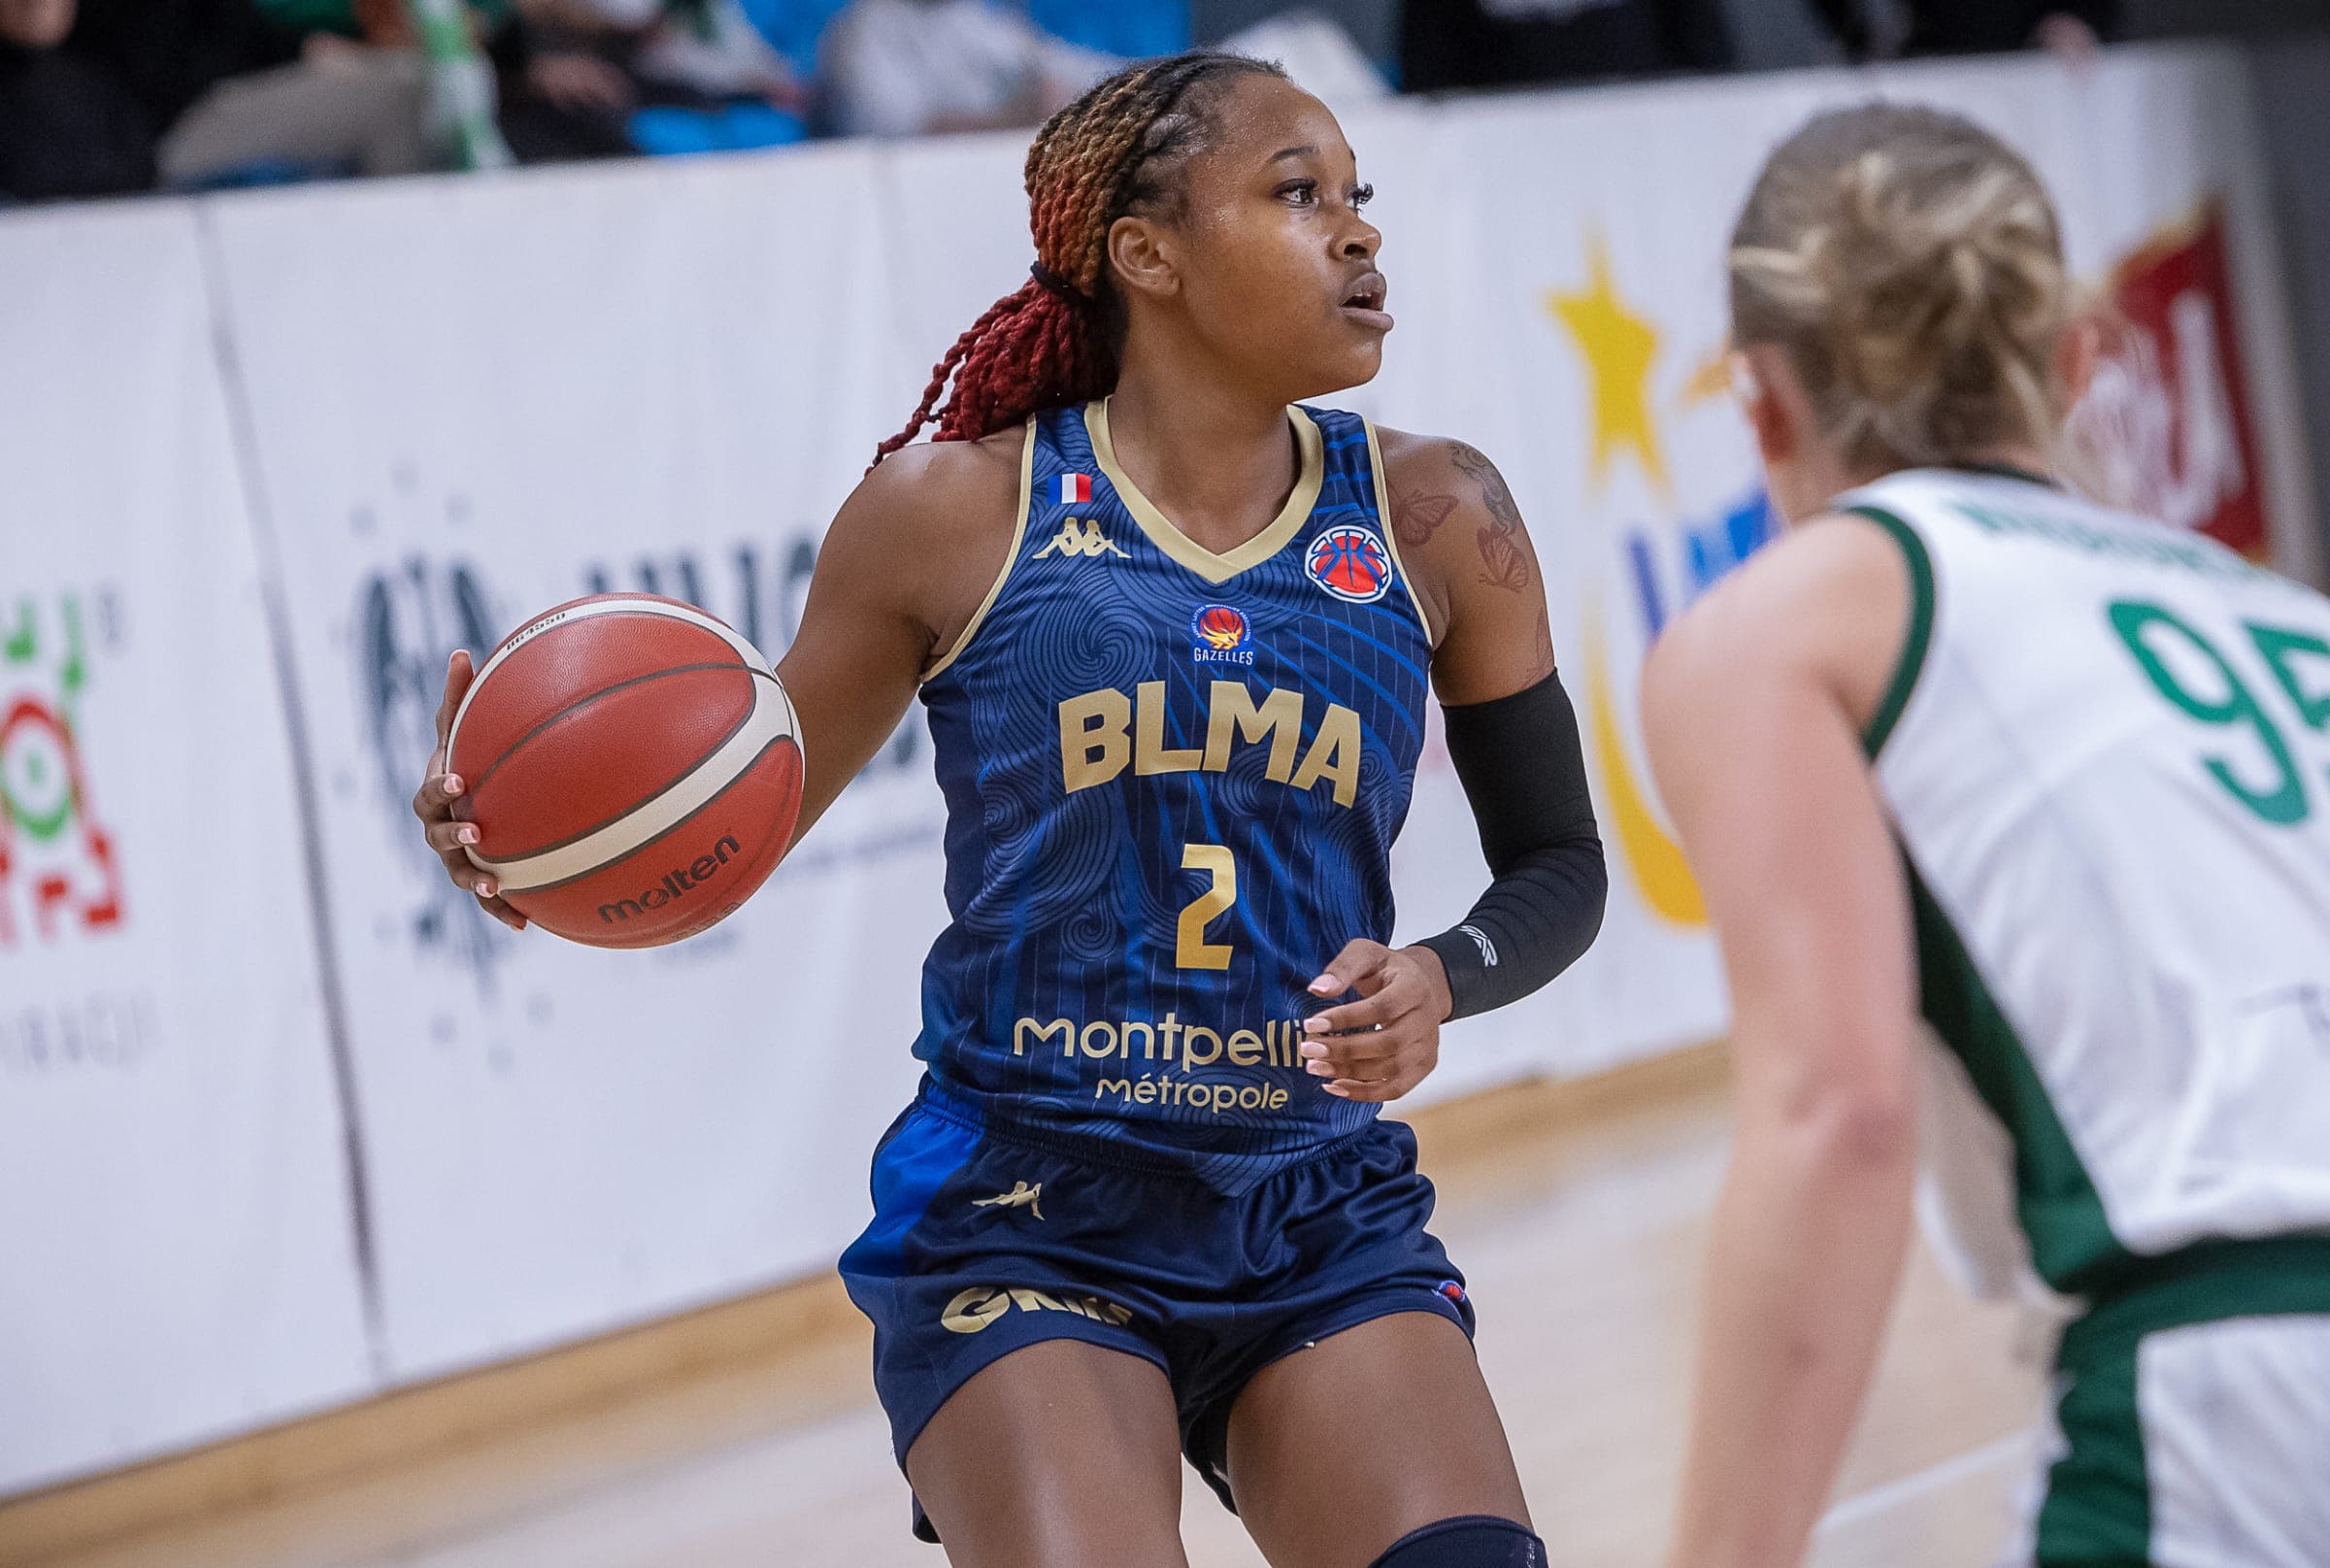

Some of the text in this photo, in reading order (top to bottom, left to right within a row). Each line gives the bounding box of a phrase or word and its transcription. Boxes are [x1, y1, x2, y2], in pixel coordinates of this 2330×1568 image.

[1193, 647, 1253, 665] GAZELLES
[1058, 681, 1361, 809] BLMA
[597, 834, 742, 923] molten
[1175, 843, 1237, 970] 2
[1014, 1012, 1304, 1073] Montpelli
